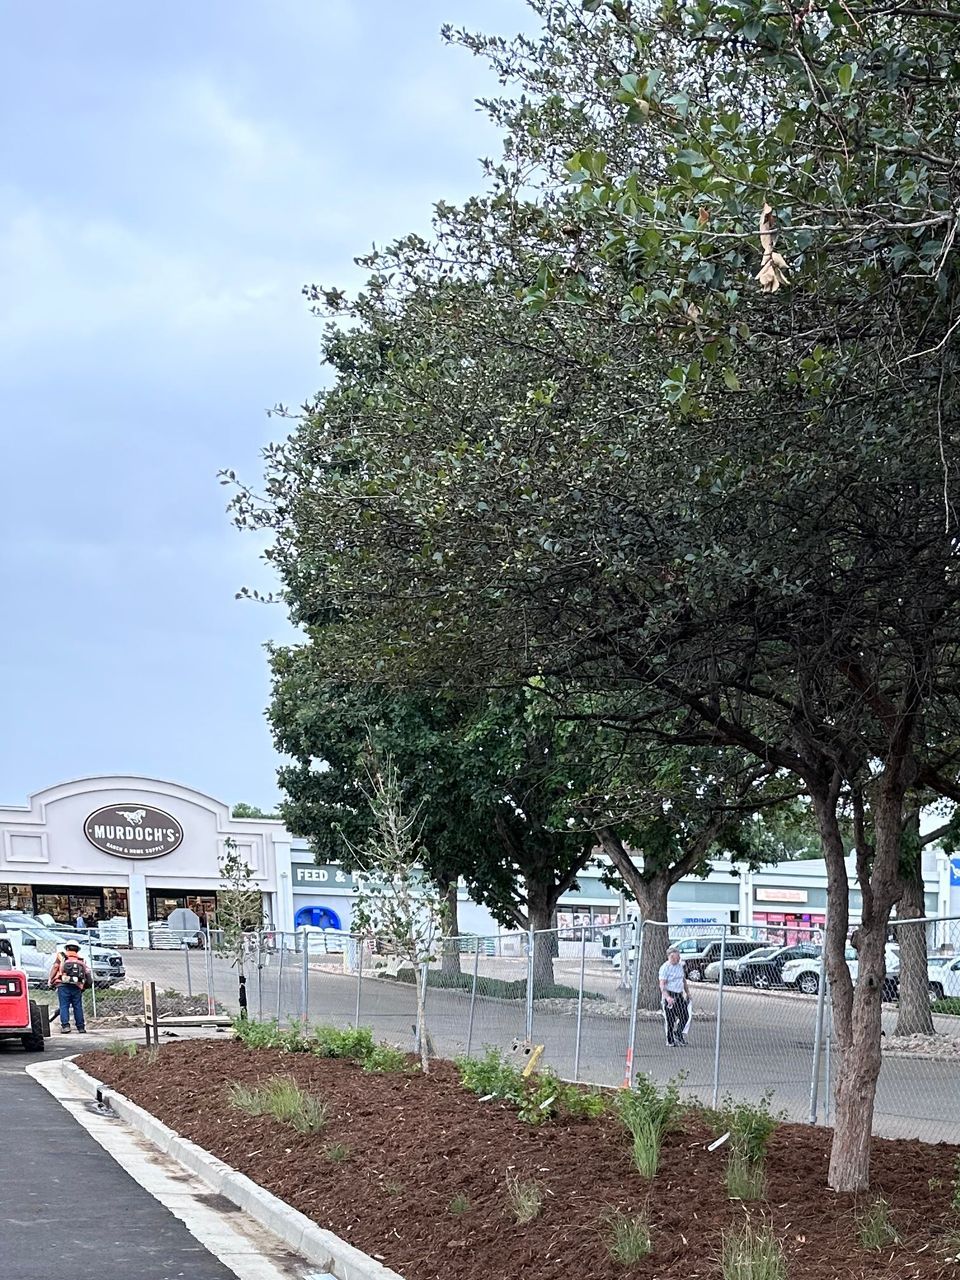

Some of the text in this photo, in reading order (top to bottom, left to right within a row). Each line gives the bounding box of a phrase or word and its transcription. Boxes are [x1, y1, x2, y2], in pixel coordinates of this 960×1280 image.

[94, 825, 175, 842] MURDOCH'S
[145, 845, 164, 854] SUPPLY
[296, 868, 329, 882] FEED
[335, 869, 346, 883] &
